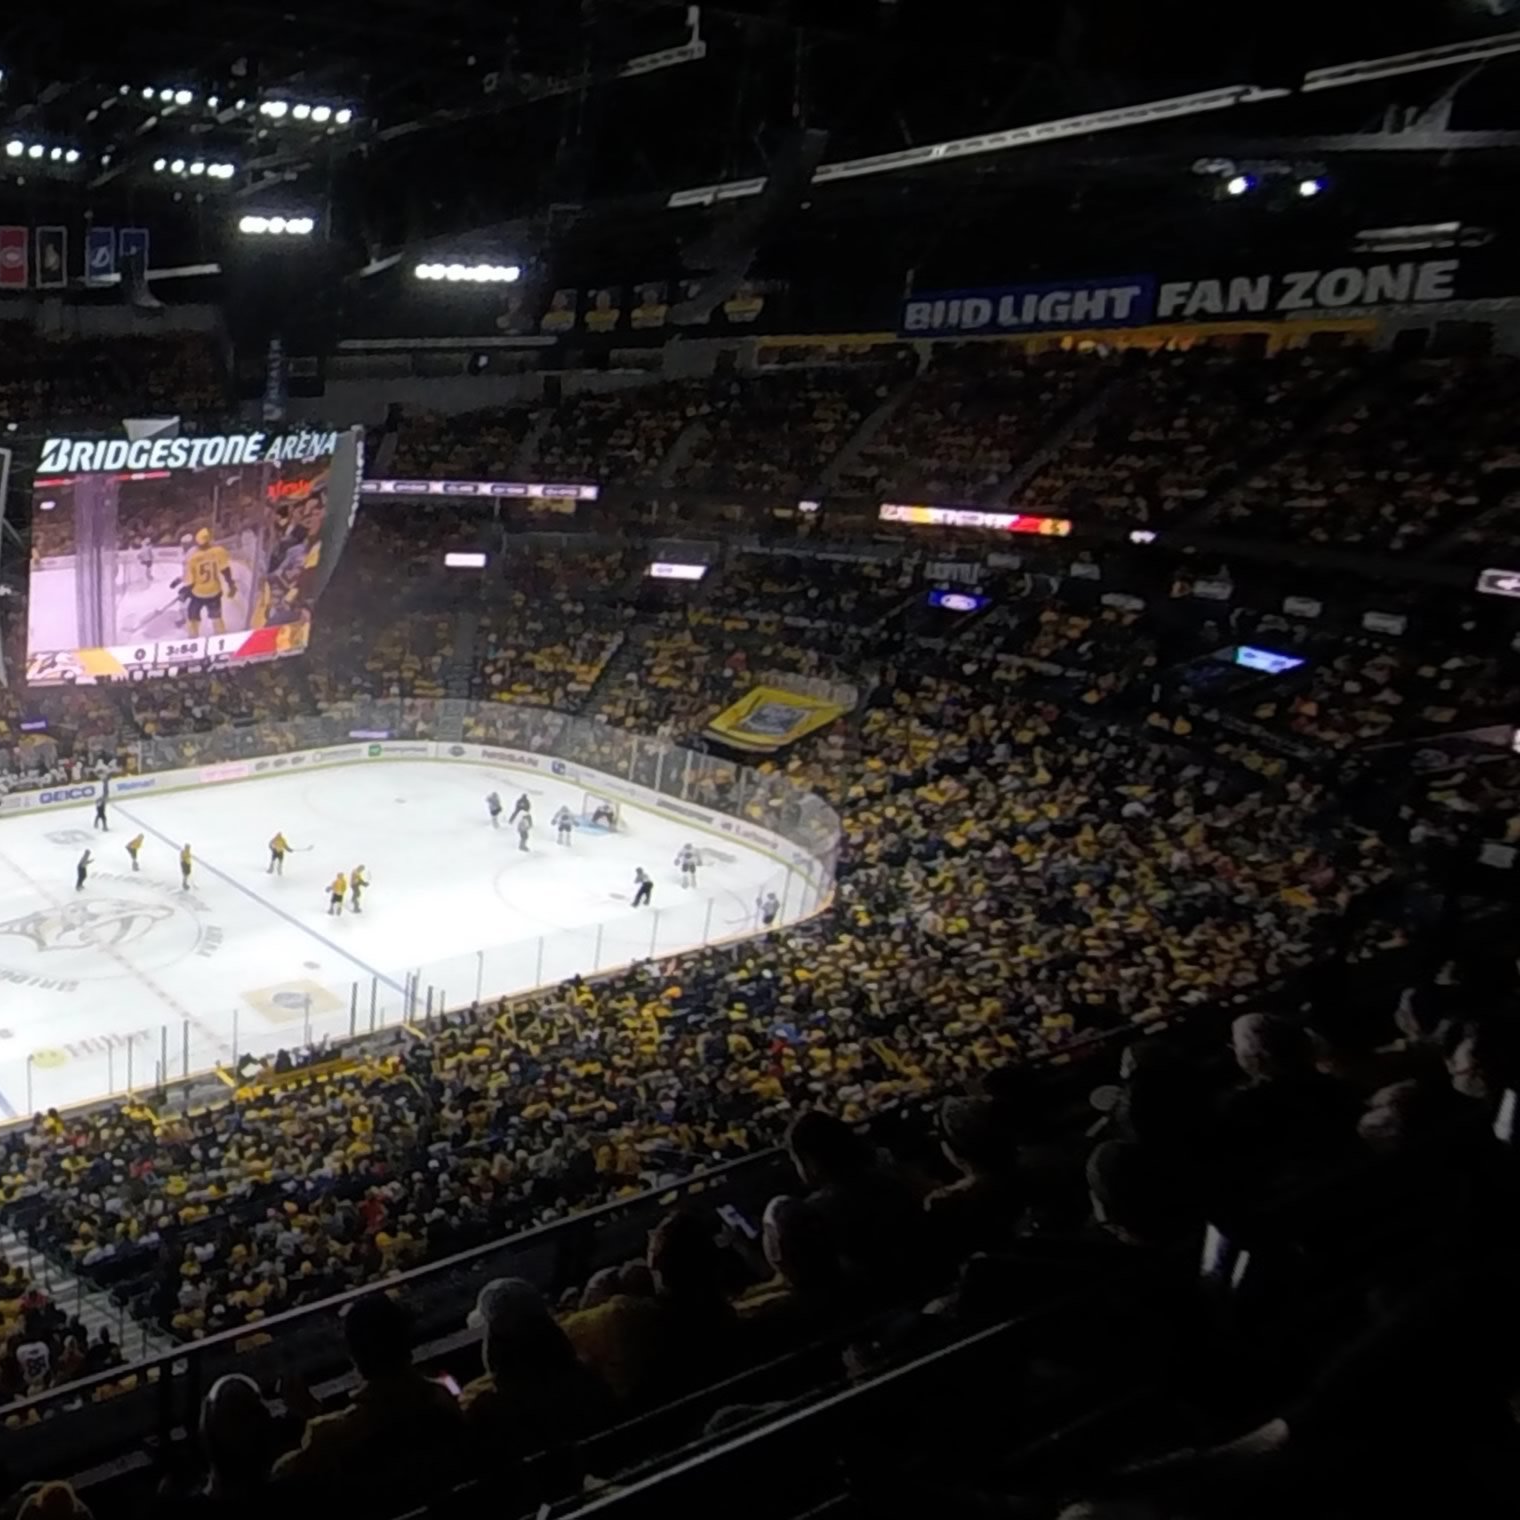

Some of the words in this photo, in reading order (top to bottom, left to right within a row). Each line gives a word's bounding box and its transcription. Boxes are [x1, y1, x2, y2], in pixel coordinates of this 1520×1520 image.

[904, 298, 993, 330] BUD
[997, 286, 1141, 326] LIGHT
[1157, 274, 1271, 317] FAN
[1276, 259, 1460, 310] ZONE
[36, 433, 265, 473] BRIDGESTONE
[264, 432, 338, 462] ARENA
[134, 648, 146, 661] 0
[39, 785, 96, 804] GEICO
